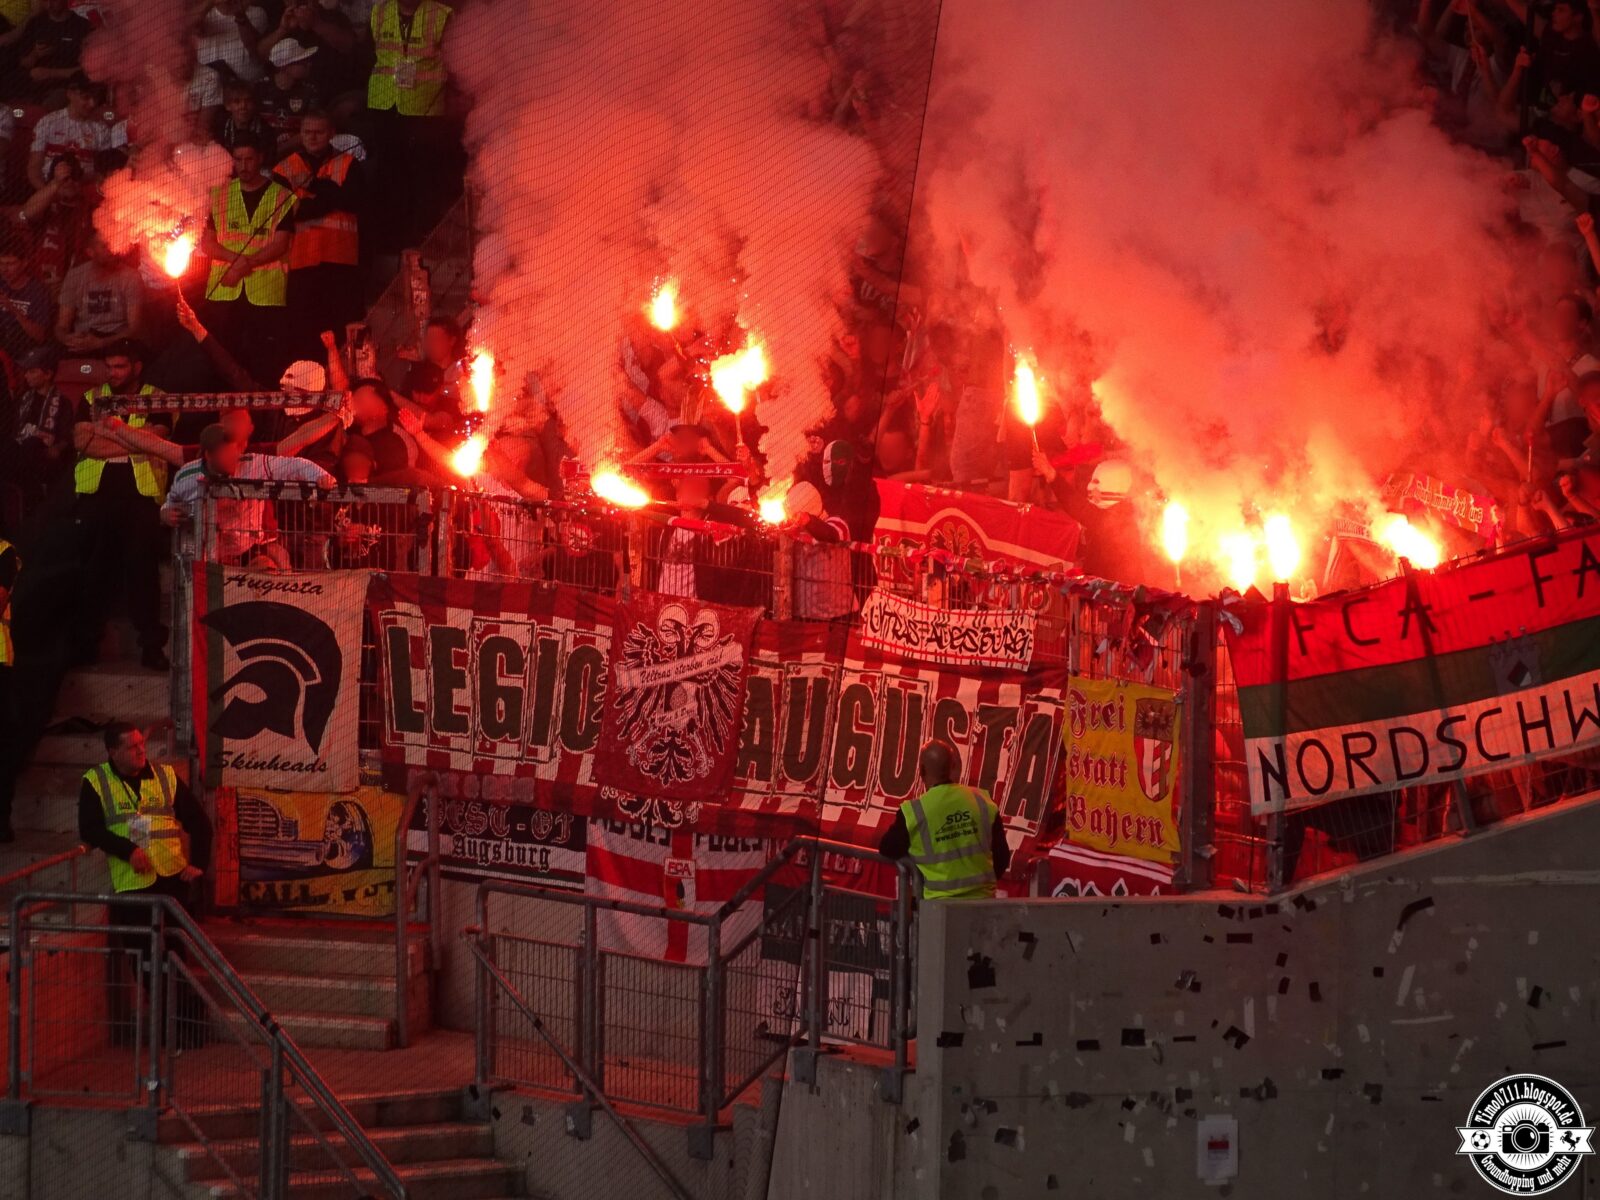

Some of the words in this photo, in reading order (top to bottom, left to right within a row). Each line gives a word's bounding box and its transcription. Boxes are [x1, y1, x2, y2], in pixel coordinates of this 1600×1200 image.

[223, 573, 322, 596] Augusta
[386, 624, 605, 754] LEGIO
[736, 676, 1056, 822] AUGUSTA
[1070, 687, 1125, 738] Frei
[211, 751, 328, 773] Skinheads
[946, 811, 970, 824] SDS
[452, 834, 551, 872] Augsburg
[668, 863, 692, 875] FCA
